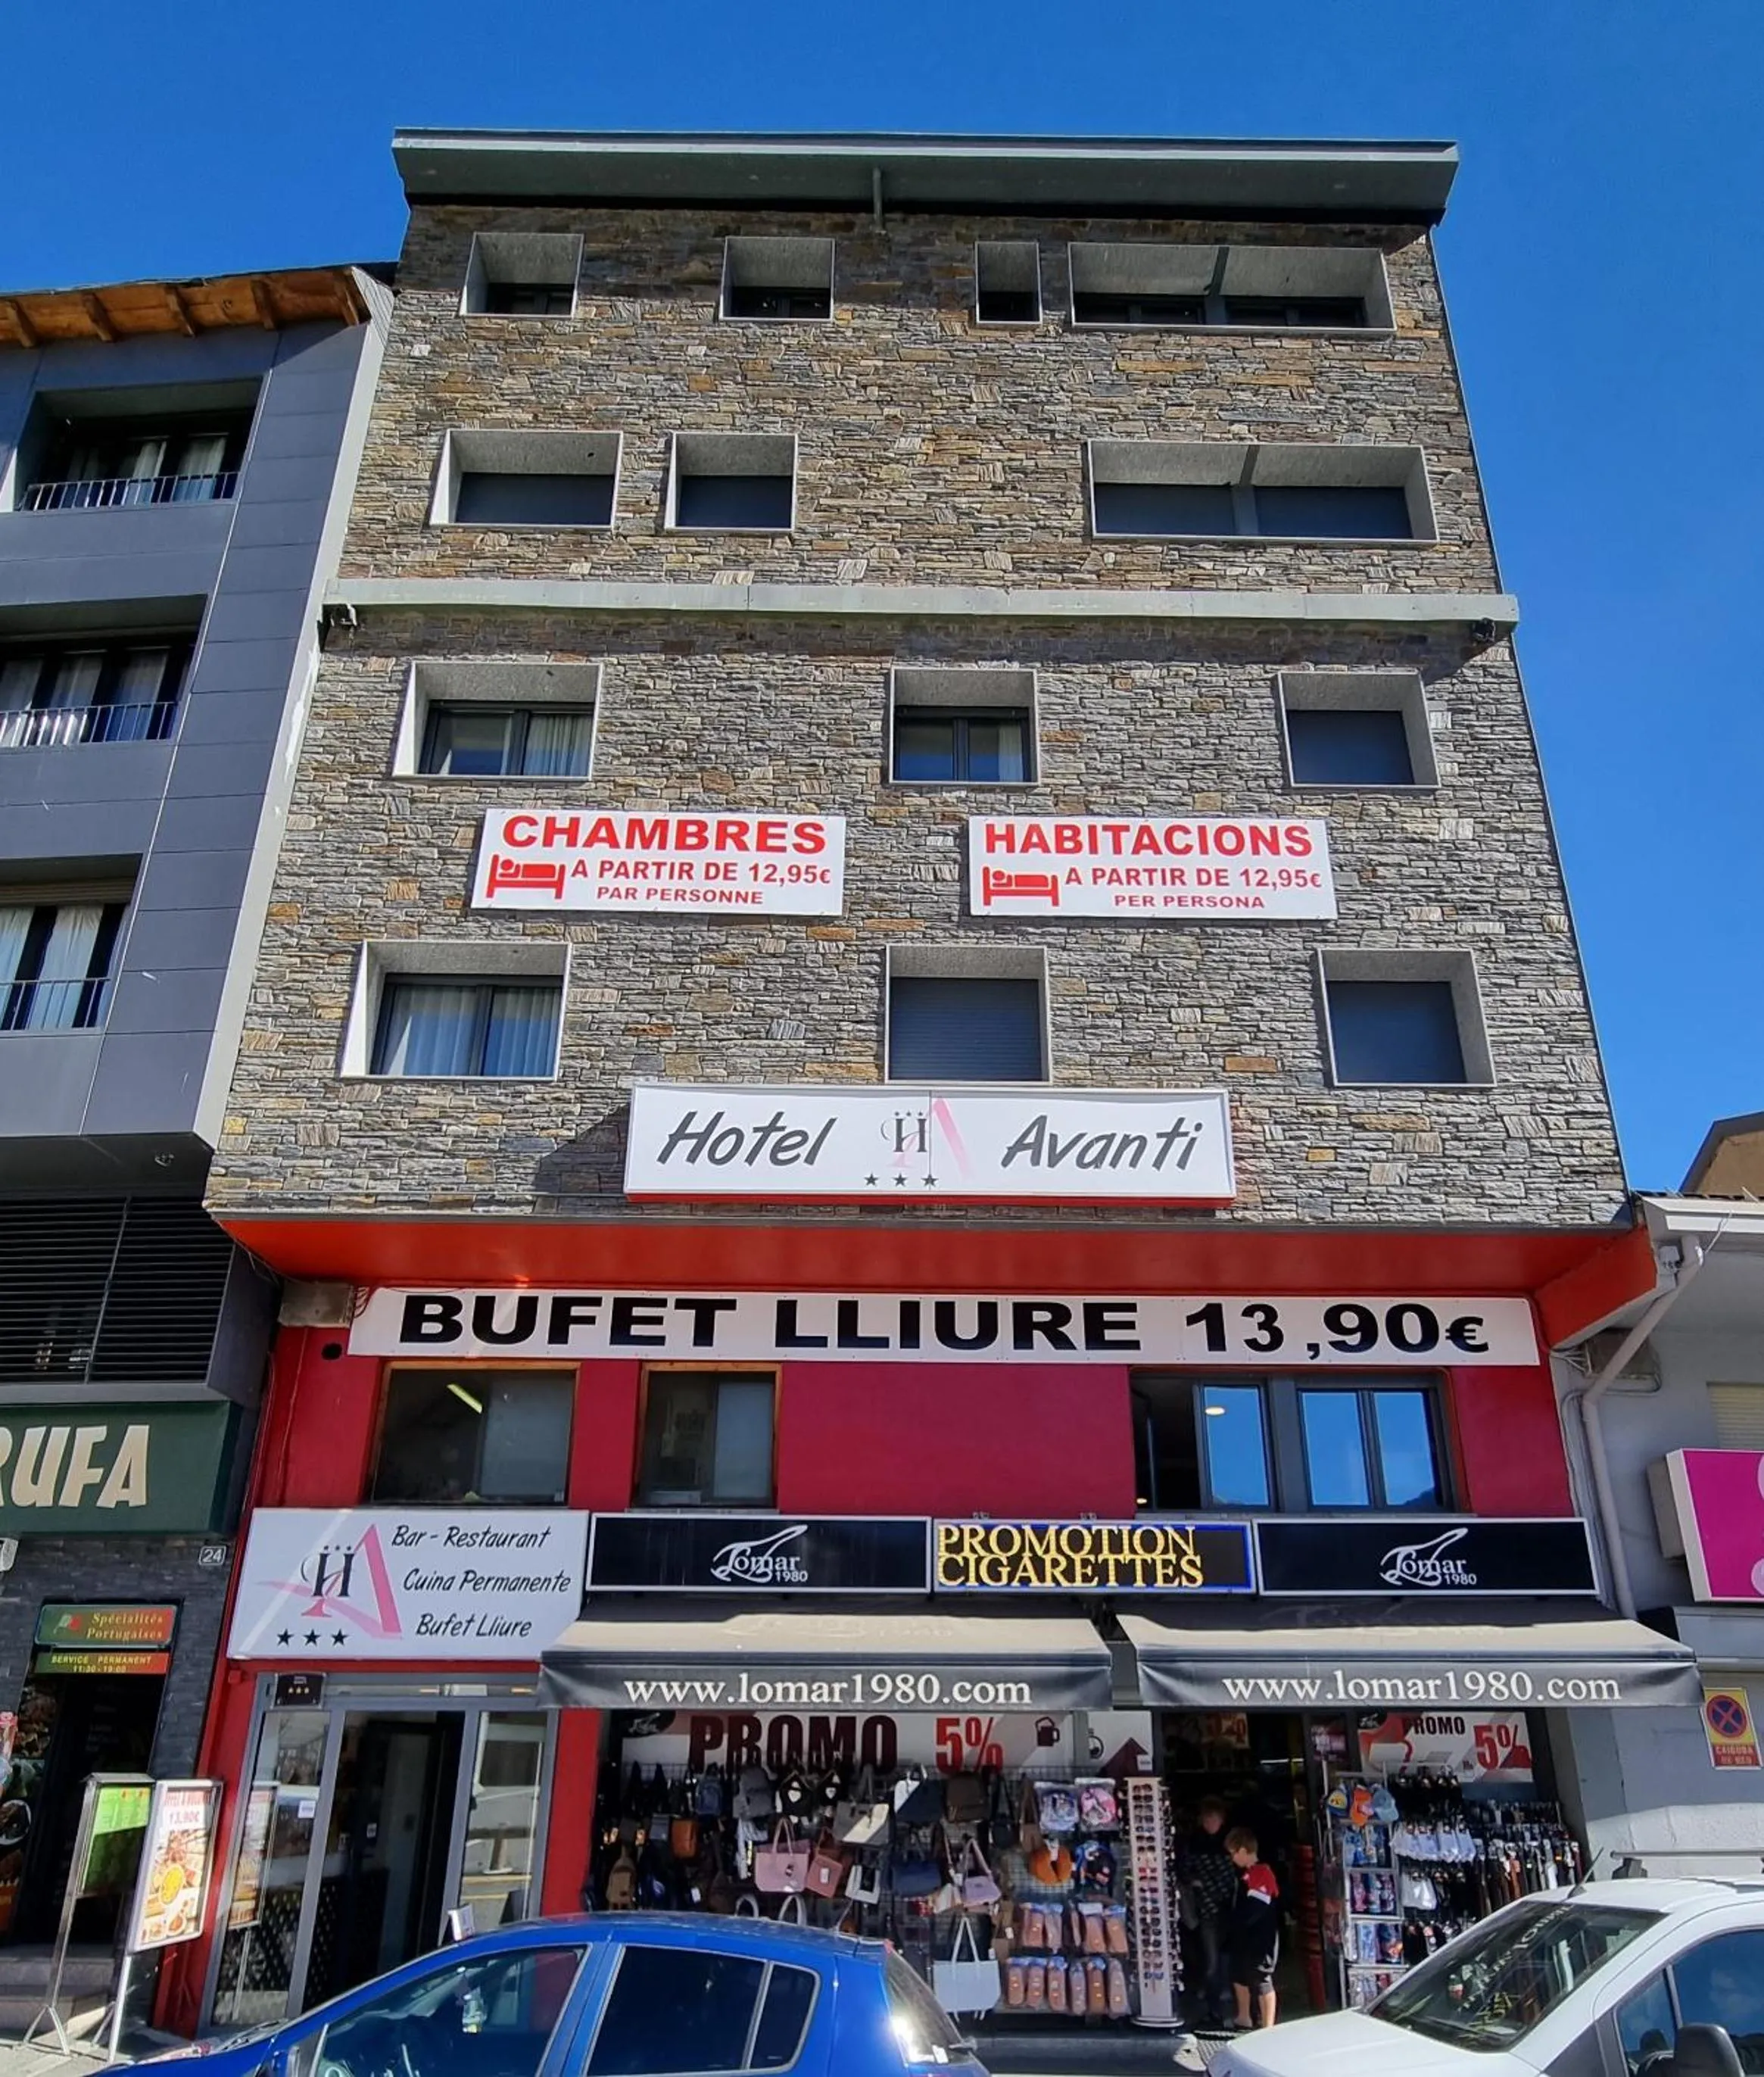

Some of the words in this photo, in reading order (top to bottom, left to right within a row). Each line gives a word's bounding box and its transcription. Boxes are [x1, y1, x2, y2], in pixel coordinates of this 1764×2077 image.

[503, 816, 827, 854] CHAMBRES
[986, 823, 1313, 857] HABITACIONS
[571, 859, 588, 878] A
[599, 861, 693, 881] PARTIR
[705, 862, 738, 881] DE
[748, 863, 831, 887] 12,95€
[1064, 868, 1082, 885] A
[1092, 868, 1186, 887] PARTIR
[1196, 869, 1229, 887] DE
[1239, 869, 1322, 891] 12,95€
[597, 887, 637, 900] PAR
[646, 888, 764, 904] PERSONNE
[1114, 896, 1156, 908] PER
[1164, 896, 1264, 908] PERSONA
[656, 1110, 838, 1167] Hotel
[1000, 1115, 1205, 1171] Avanti
[399, 1295, 737, 1347] BUFET
[774, 1299, 1142, 1352] LLIURE
[1184, 1302, 1490, 1361] 13,90€
[391, 1524, 425, 1547] Bar
[443, 1525, 551, 1548] Restaurant
[937, 1524, 1196, 1557] PROMOTION
[202, 1549, 222, 1563] 24
[404, 1568, 456, 1592] Cuina
[459, 1570, 572, 1593] Permanente
[774, 1570, 809, 1583] 1980
[937, 1555, 1204, 1589] CIGARETTES
[1445, 1574, 1477, 1586] 1980
[86, 1628, 163, 1642] Portugaises
[416, 1613, 474, 1637] Bufet
[476, 1614, 532, 1638] Lliure
[51, 1654, 89, 1664] SERVICE
[98, 1654, 152, 1664] PERMANENT
[623, 1673, 1033, 1704] www.lomar1980.com
[1222, 1670, 1622, 1701] www.lomar1980.com
[1404, 1716, 1466, 1736] PROMO
[687, 1715, 898, 1773] PROMO
[935, 1717, 1004, 1775] 5%
